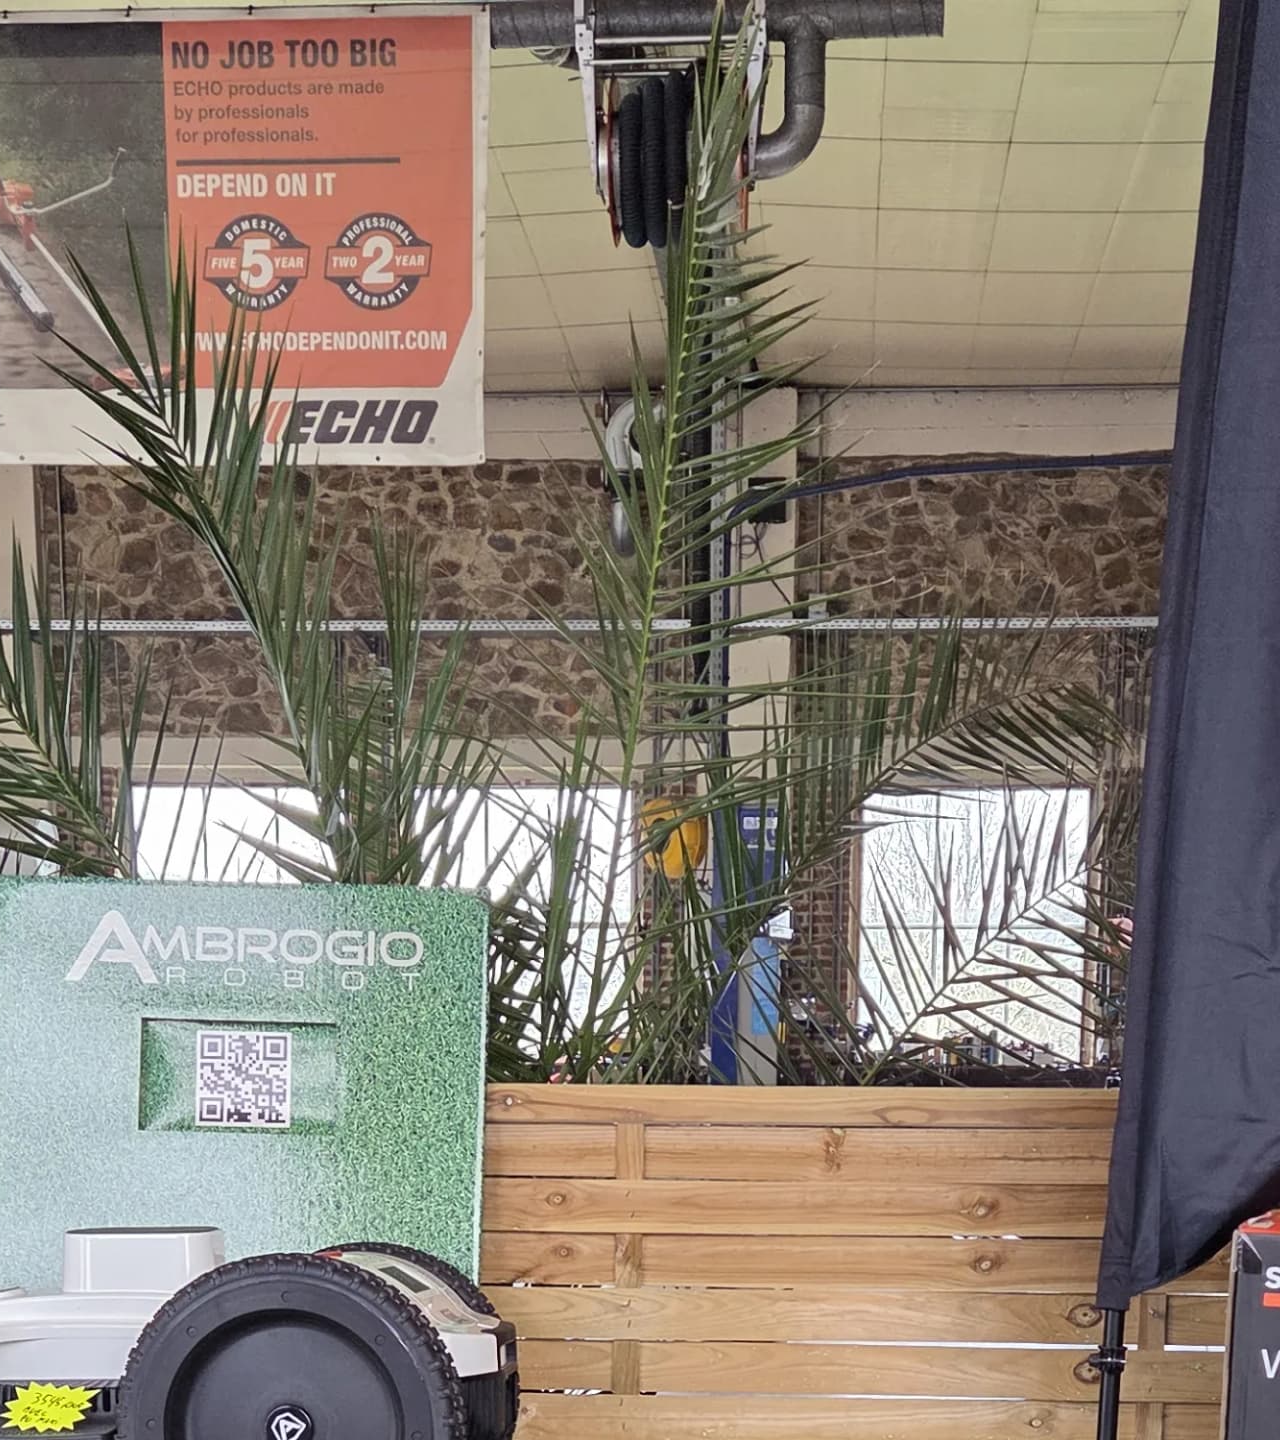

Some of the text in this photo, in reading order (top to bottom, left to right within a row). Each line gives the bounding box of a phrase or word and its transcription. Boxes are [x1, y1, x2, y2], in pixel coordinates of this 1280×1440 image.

[171, 38, 397, 69] NO JOB TOO BIG
[173, 79, 385, 99] ECHO products are made
[174, 103, 309, 122] by professionals
[176, 126, 319, 145] for professionals.
[176, 172, 337, 198] DEPEND ON IT
[225, 218, 287, 242] DOMESTIC
[341, 217, 413, 246] PROFESSIONAL
[211, 238, 304, 288] FIVE 5 YEAR
[332, 235, 425, 284] TWO 2 YEAR
[346, 282, 409, 307] WARRANTY
[283, 400, 439, 444] ECHO
[166, 967, 421, 991] ROBOT
